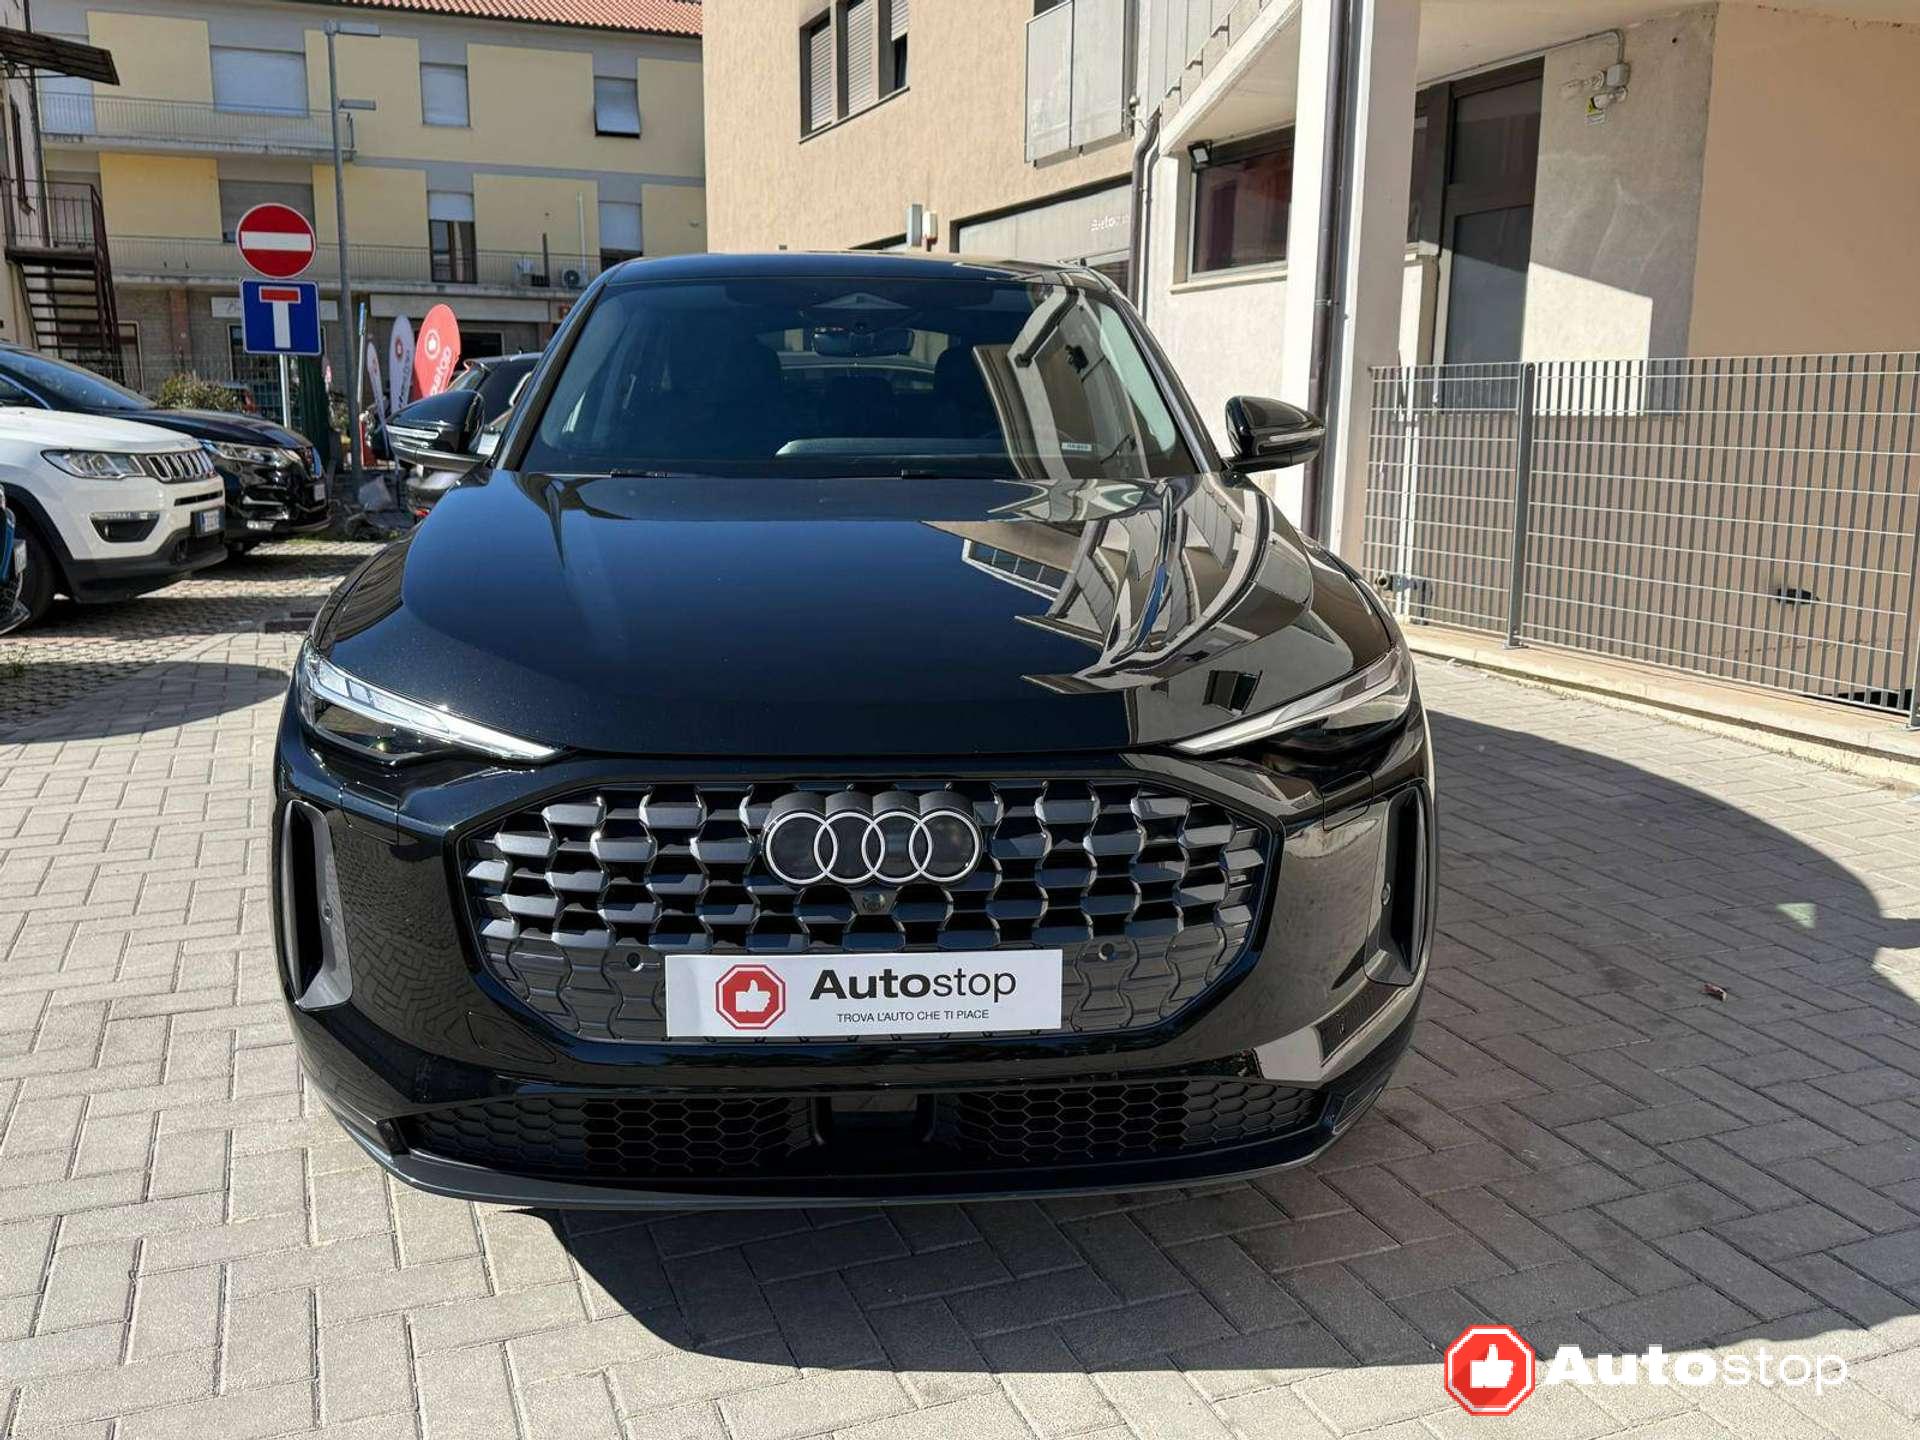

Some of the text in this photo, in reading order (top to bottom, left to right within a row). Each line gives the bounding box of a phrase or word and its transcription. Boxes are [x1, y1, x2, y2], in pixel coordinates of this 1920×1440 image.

[809, 967, 1017, 1003] Autostop
[837, 1009, 990, 1023] TROVA L'AUTO CHE TI PIACE
